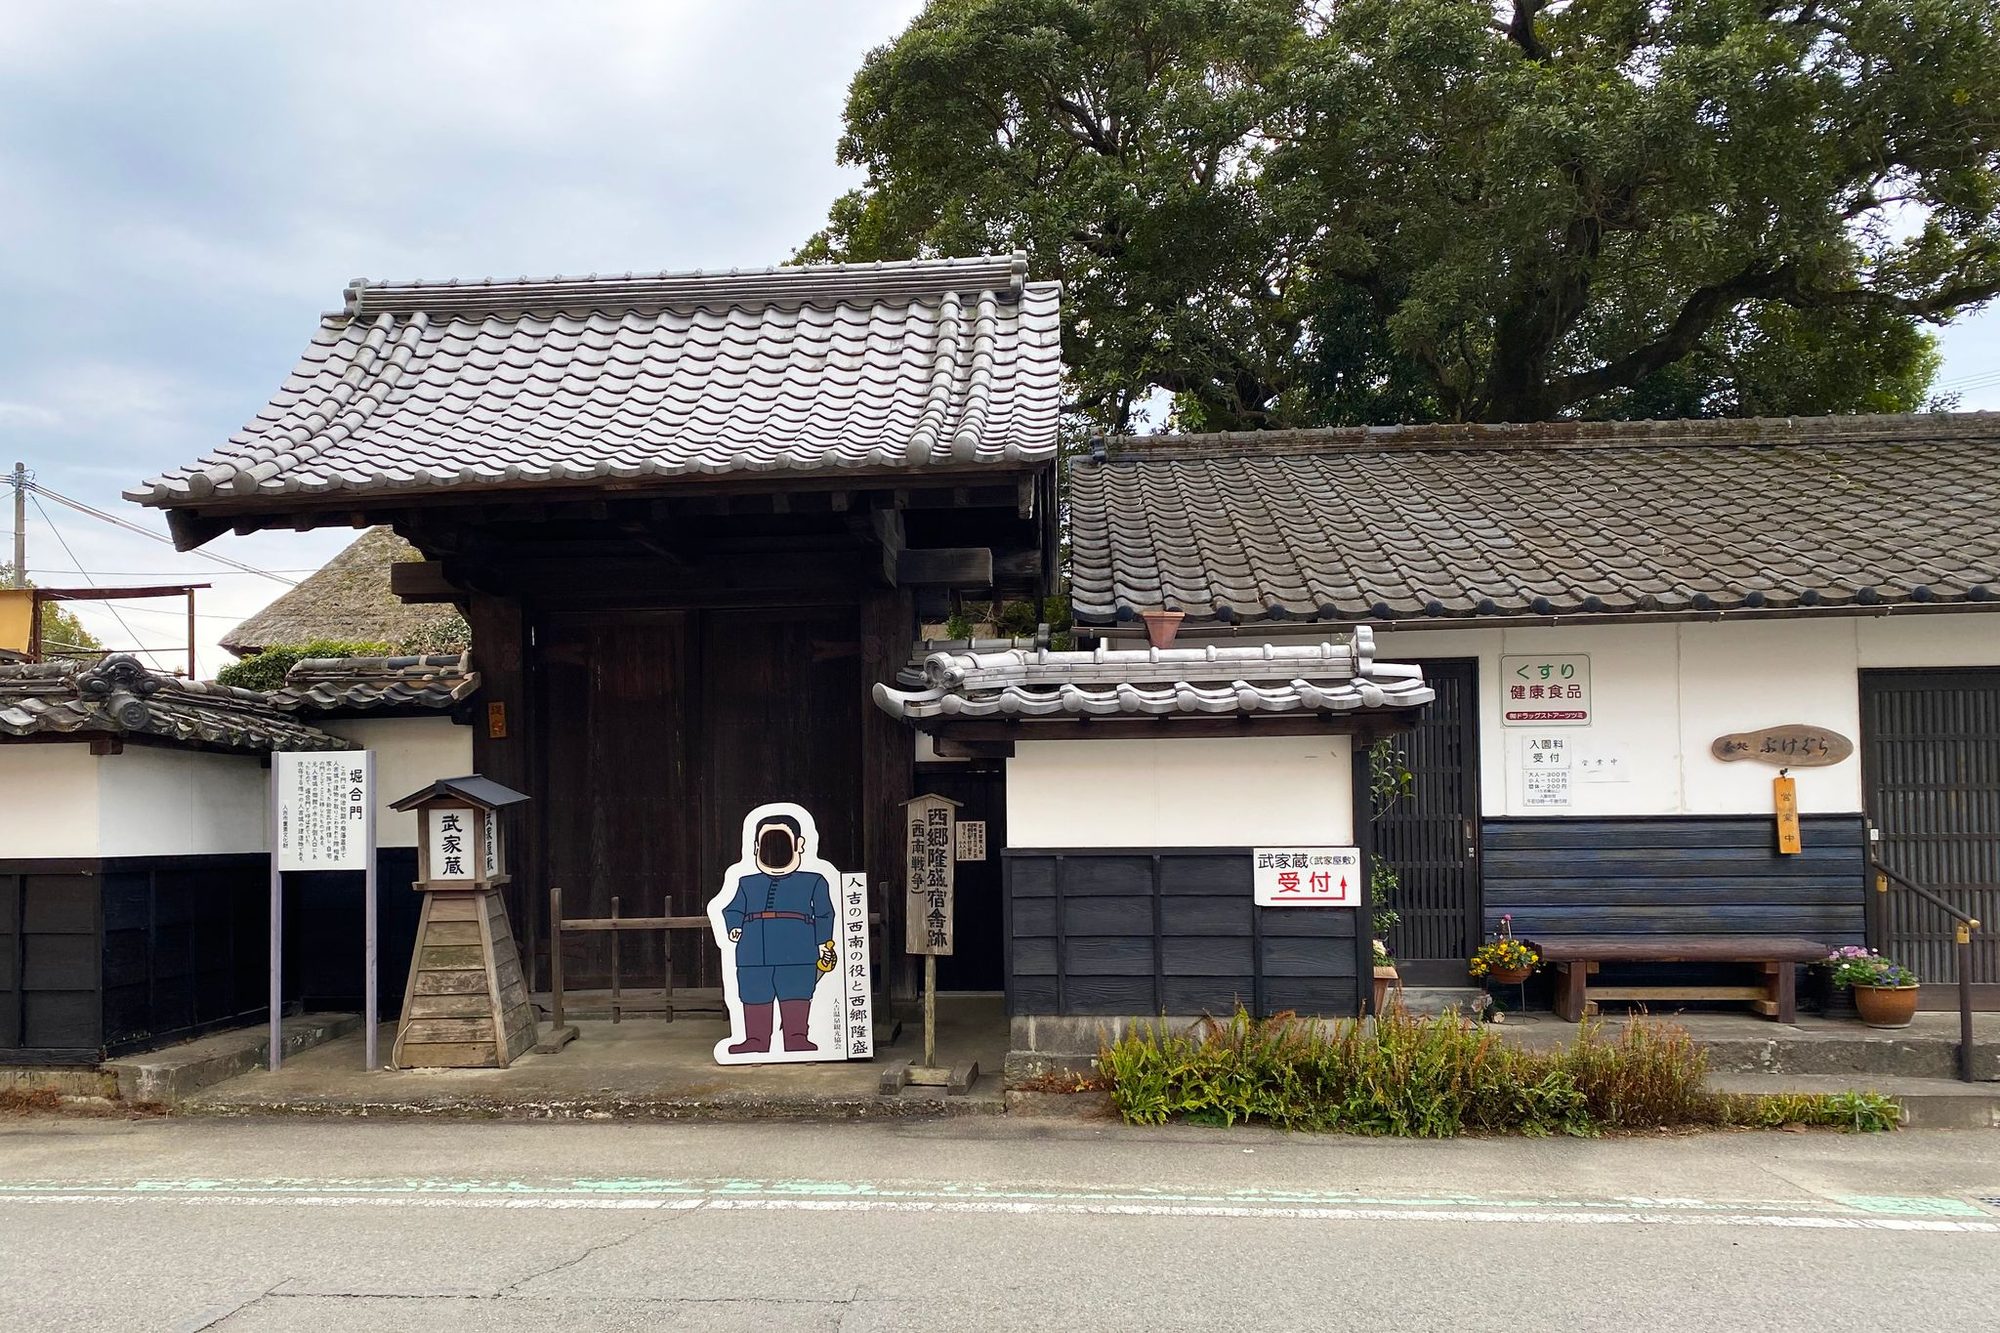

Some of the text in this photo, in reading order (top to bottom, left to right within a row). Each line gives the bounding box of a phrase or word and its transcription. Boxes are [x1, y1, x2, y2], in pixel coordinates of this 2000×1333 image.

[1516, 664, 1575, 680] くすり
[1510, 684, 1582, 700] 健康食品
[1529, 739, 1564, 750] 入園料
[1533, 753, 1560, 763] 受付
[349, 769, 363, 820] 堀合門
[441, 813, 465, 876] 武家蔵
[911, 818, 925, 895] （西南戦争）
[1258, 853, 1309, 869] 武家蔵
[926, 808, 949, 948] 西郷隆盛宿舎跡
[1278, 871, 1332, 893] 受付
[846, 877, 869, 1055] 人吉の西南の役と西郷隆盛
